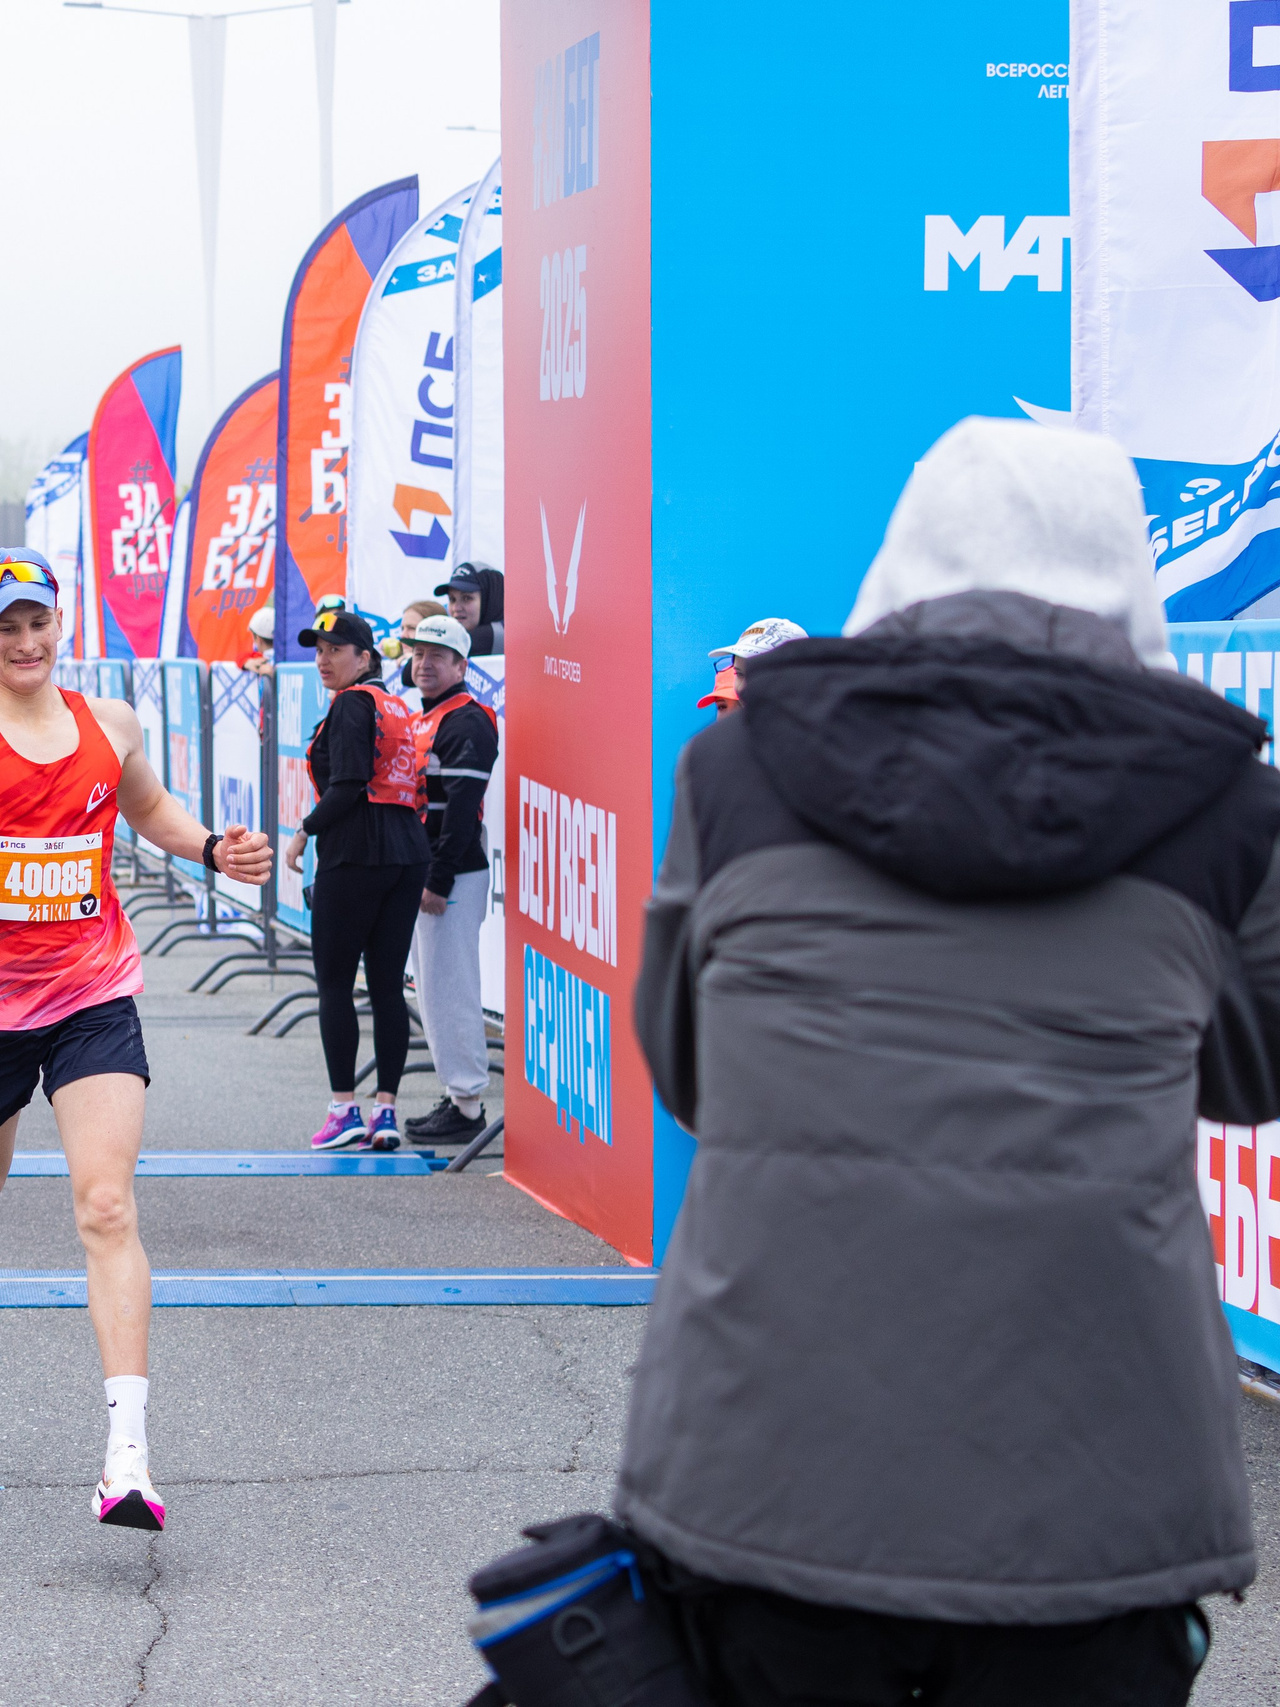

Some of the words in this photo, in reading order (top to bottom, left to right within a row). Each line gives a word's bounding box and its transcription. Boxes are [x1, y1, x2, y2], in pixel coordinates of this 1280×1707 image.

[986, 63, 1070, 79] ВСЕРОСС
[540, 245, 587, 401] 2025
[118, 482, 165, 529] ЗА
[221, 483, 277, 537] ЗА
[111, 525, 172, 576] БЕГ
[544, 655, 559, 675] ЛИГА
[559, 657, 581, 683] ГЕРОЕВ
[5, 859, 92, 897] 40085
[519, 775, 558, 932] БЕГУ
[559, 793, 617, 968] ВСЕМ
[524, 943, 612, 1147] СЕРДЦЕМ
